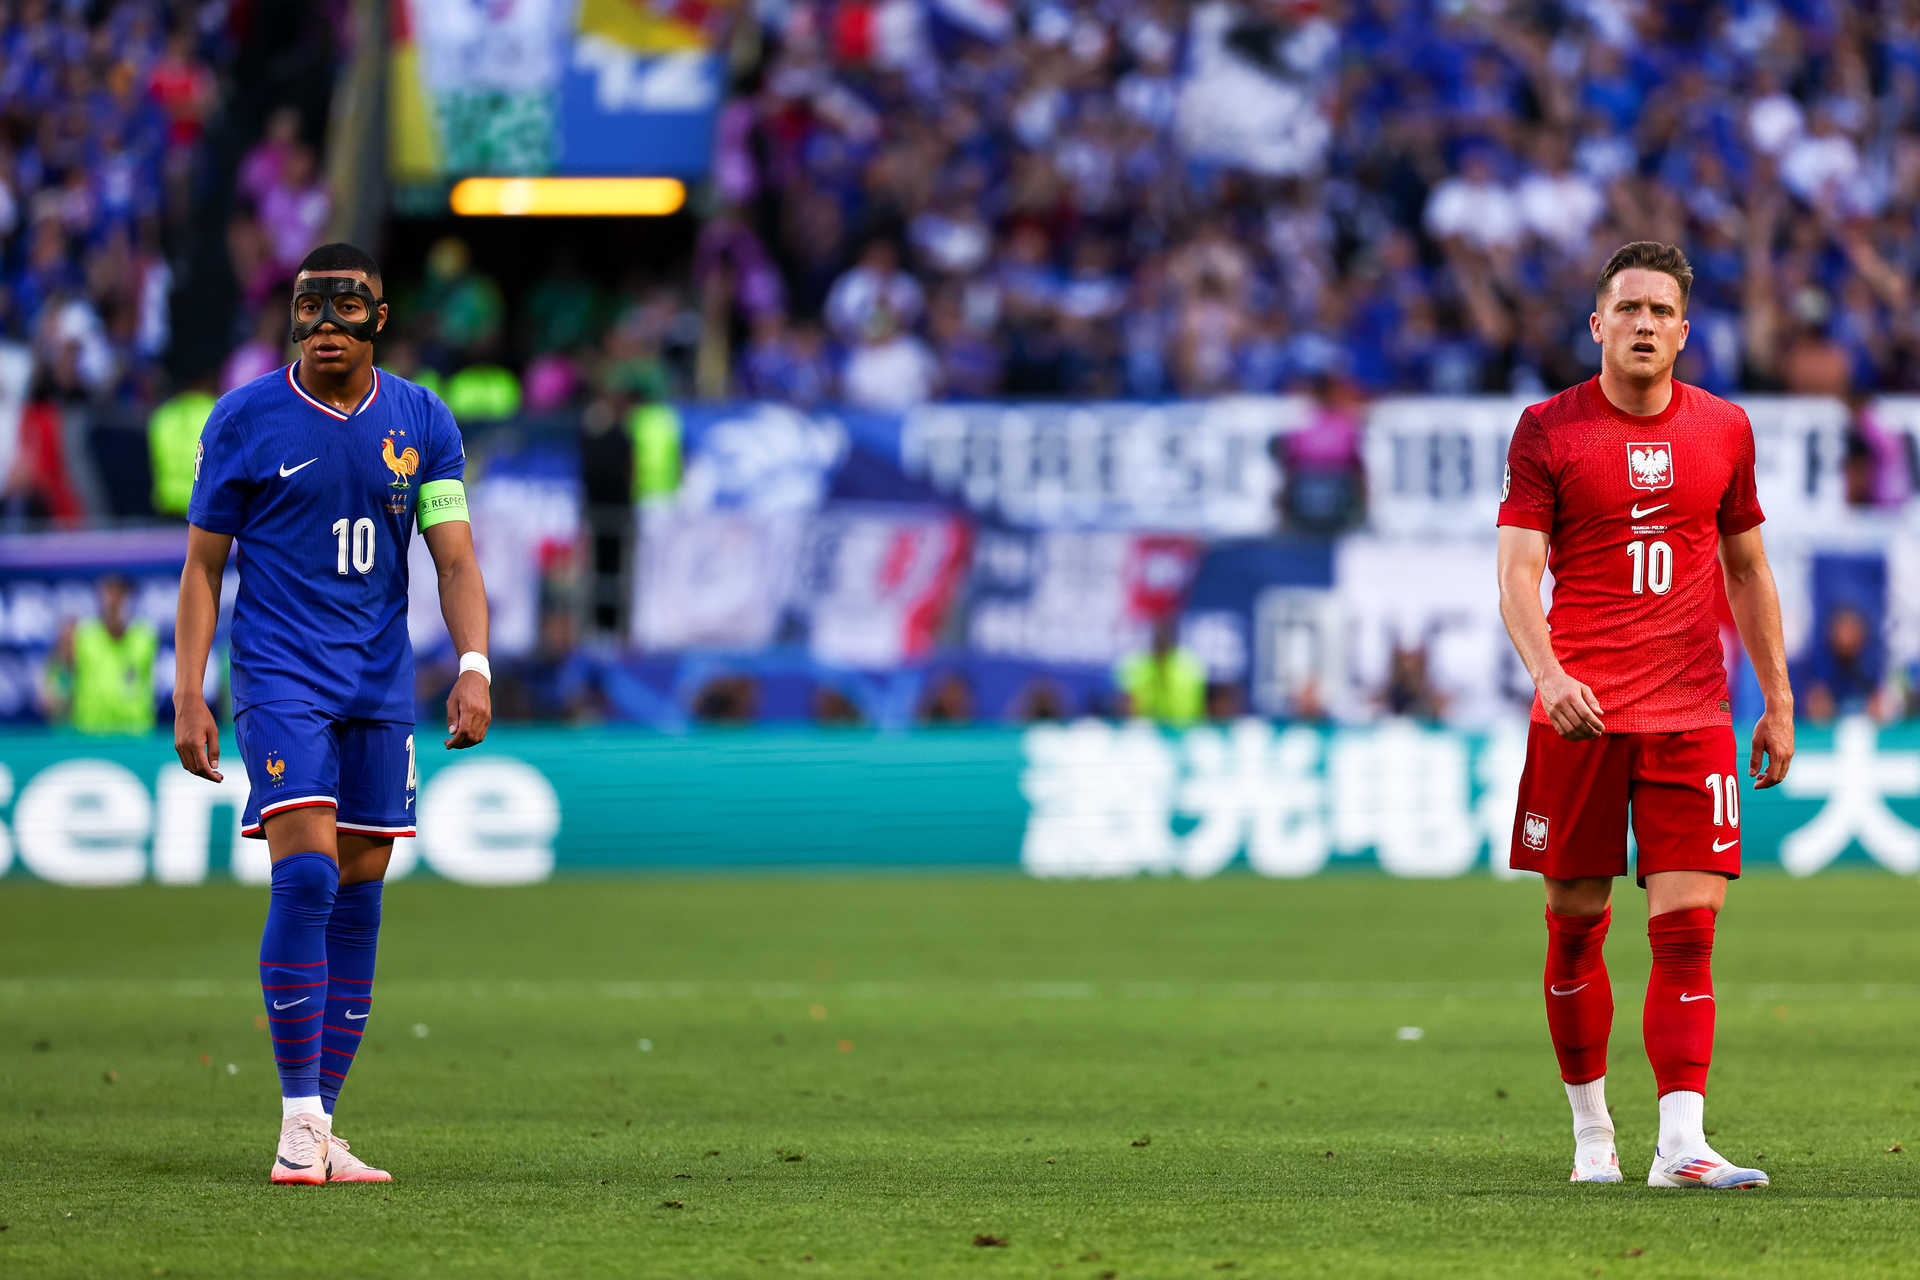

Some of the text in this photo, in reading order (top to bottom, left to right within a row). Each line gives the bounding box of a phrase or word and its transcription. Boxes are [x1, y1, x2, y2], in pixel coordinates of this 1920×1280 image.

[332, 517, 376, 575] 10
[1626, 540, 1673, 596] 10
[0, 757, 561, 886] ene
[1705, 773, 1739, 829] 10
